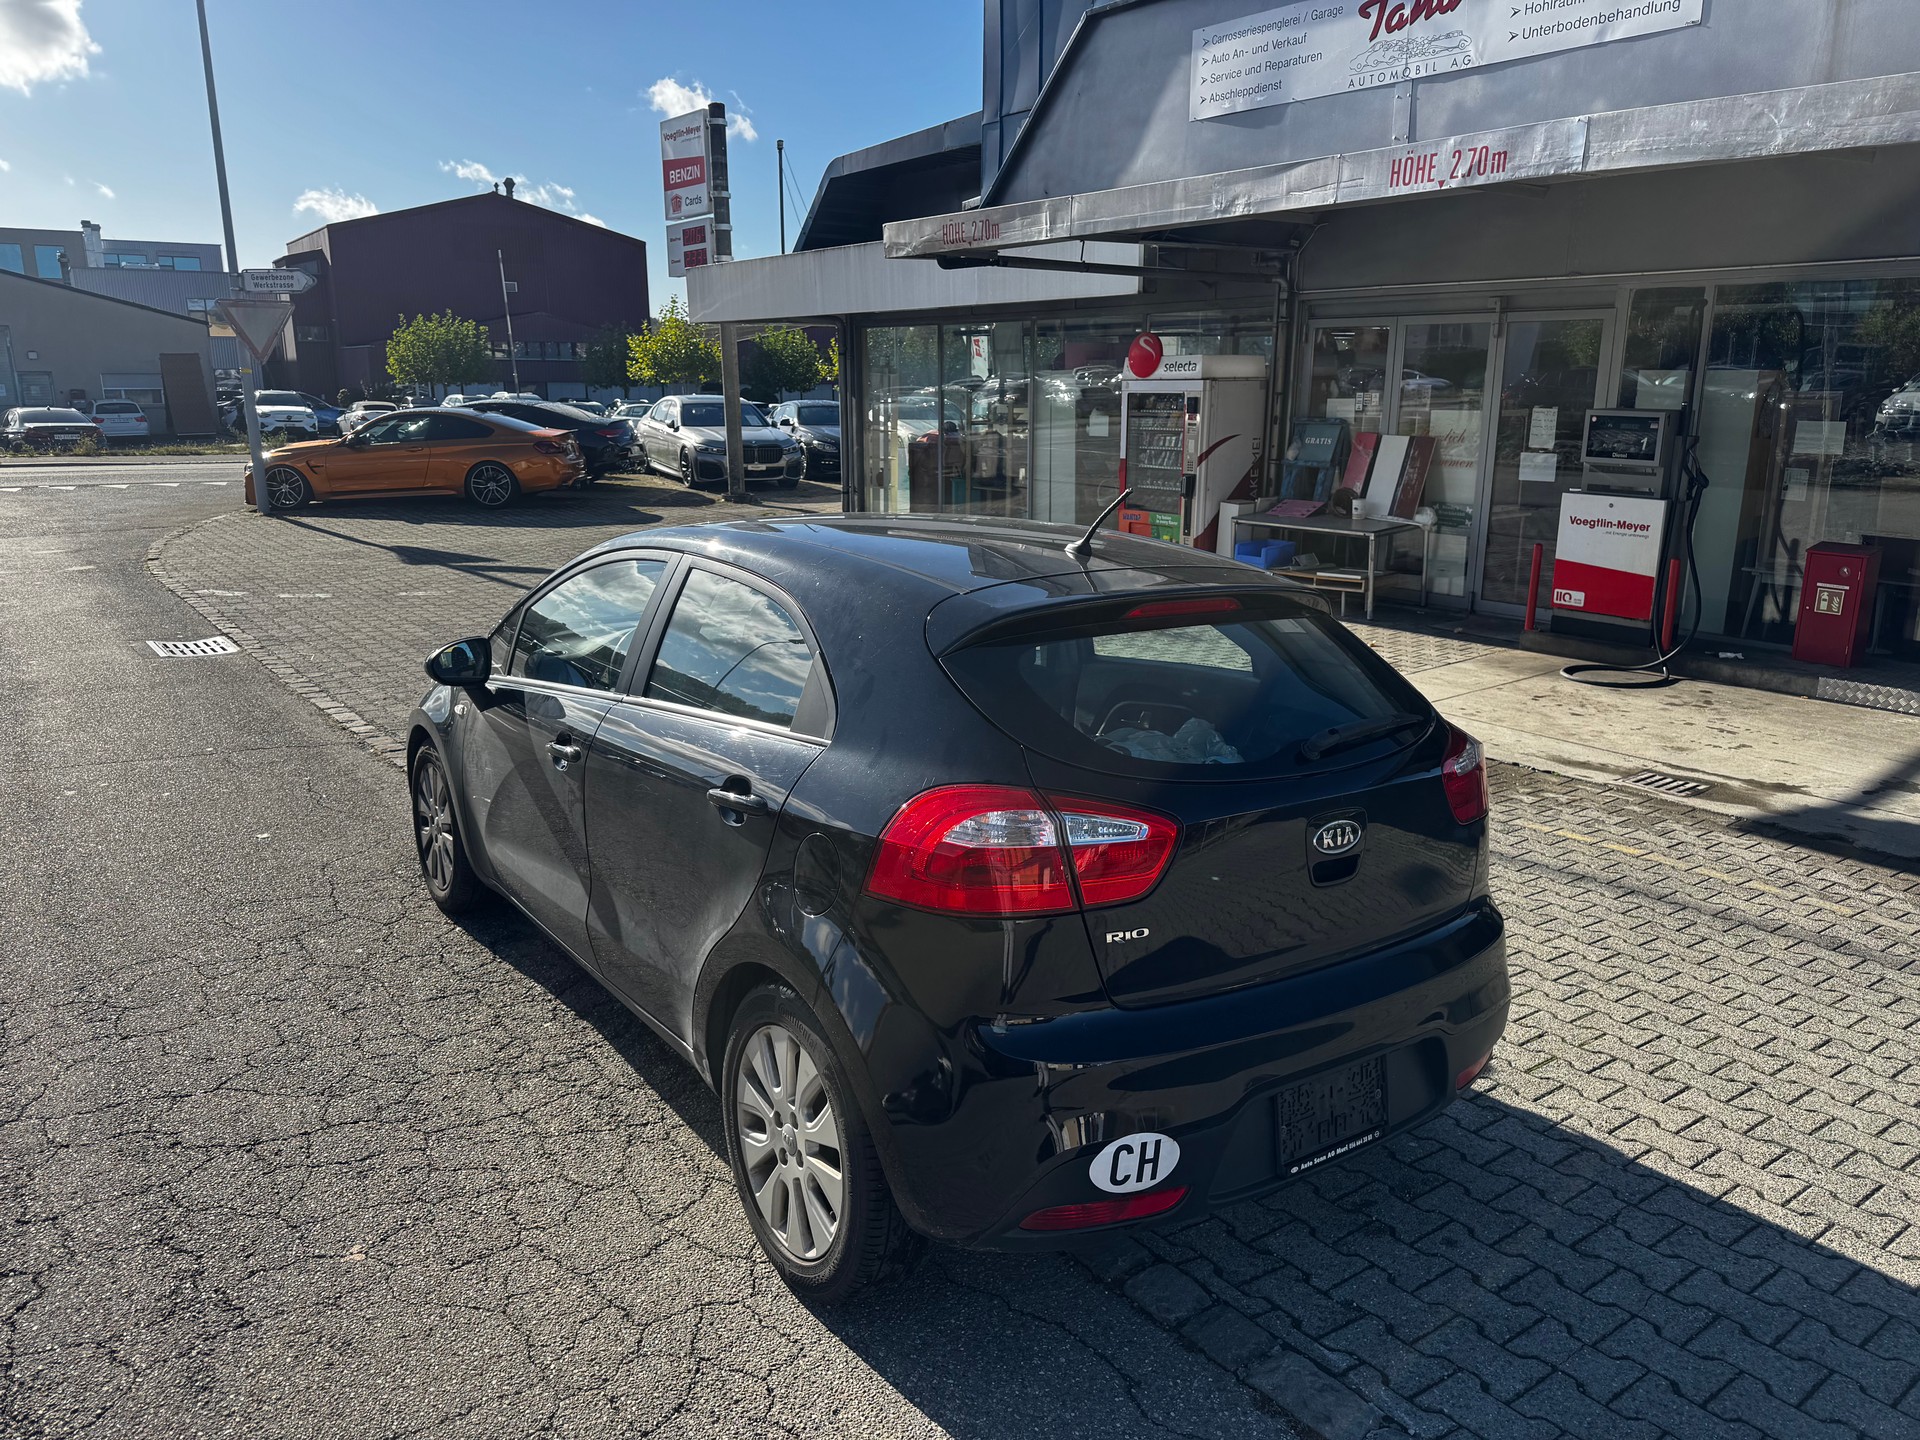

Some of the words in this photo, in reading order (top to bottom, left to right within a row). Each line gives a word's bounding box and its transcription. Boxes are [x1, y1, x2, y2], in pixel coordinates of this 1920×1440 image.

[1212, 14, 1300, 46] Carrosseriespenglerei
[1303, 12, 1308, 23] /
[1311, 5, 1344, 21] Garage
[1522, 0, 1681, 40] Unterbodenbehandlung
[1210, 53, 1230, 64] Auto
[1232, 48, 1248, 60] An-
[1252, 43, 1268, 55] und
[1271, 32, 1307, 50] Verkauf
[1210, 69, 1242, 84] Service
[1245, 63, 1261, 76] und
[1265, 52, 1322, 71] Reparaturen
[1348, 63, 1437, 88] AUTOMOBIL
[1450, 55, 1472, 68] AG
[1209, 80, 1282, 103] Abschleppdienst
[669, 165, 700, 184] BENZIN
[1390, 150, 1438, 188] HÖHE
[685, 194, 702, 206] Cards
[942, 219, 966, 245] HÖHE
[1164, 360, 1197, 372] selecta
[1305, 437, 1332, 445] GRATIS
[1641, 437, 1648, 450] 1
[1570, 516, 1650, 532] Voegtlin-Meyer
[1322, 826, 1354, 848] KIA
[1106, 928, 1150, 943] RIO
[1110, 1139, 1161, 1186] CH
[1300, 1161, 1312, 1170] Auto
[1327, 1150, 1335, 1158] AG
